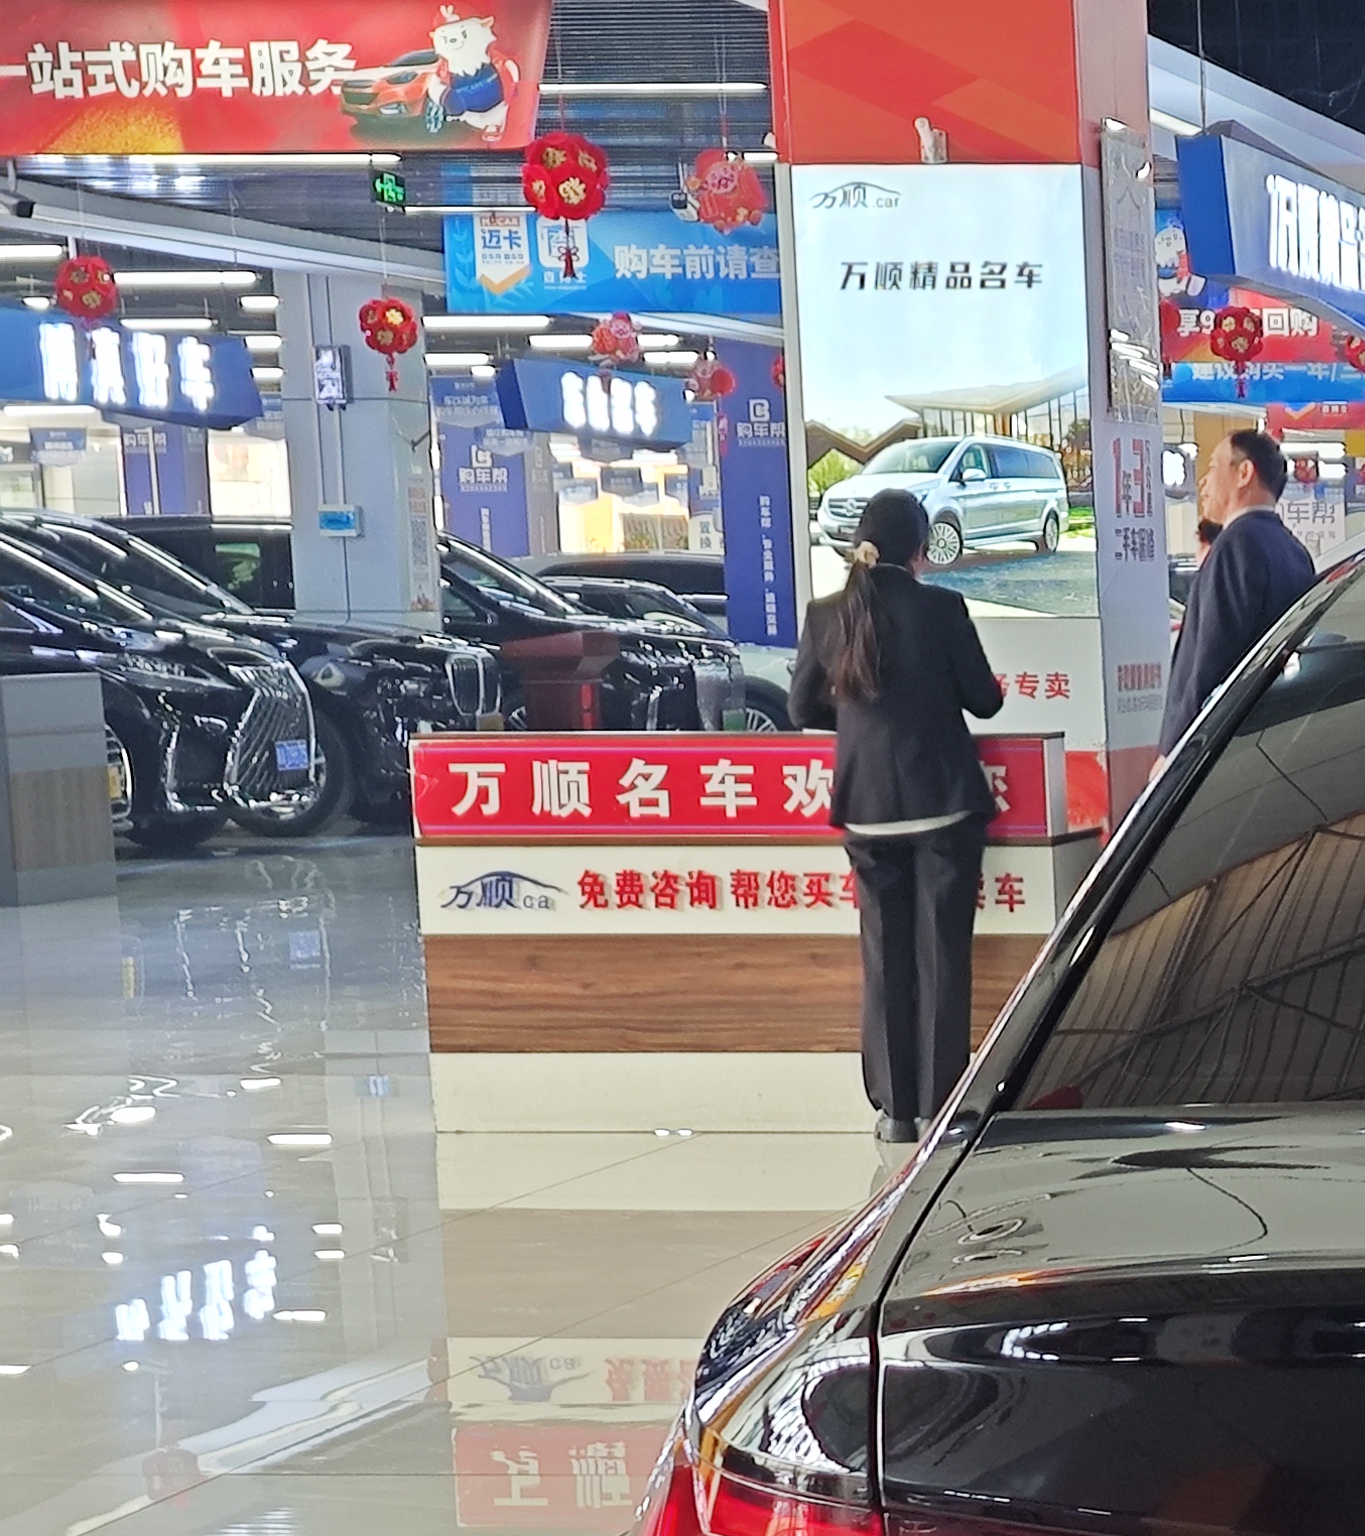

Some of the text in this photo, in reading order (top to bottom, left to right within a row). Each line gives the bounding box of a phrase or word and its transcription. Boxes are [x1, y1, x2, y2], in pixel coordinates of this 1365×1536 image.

[0, 39, 357, 99] 一站式购车服务
[481, 229, 522, 250] 迈卡
[840, 261, 1043, 290] 万顺精品名车
[449, 758, 1008, 819] 万顺名车欢
[577, 869, 718, 910] 免费咨询
